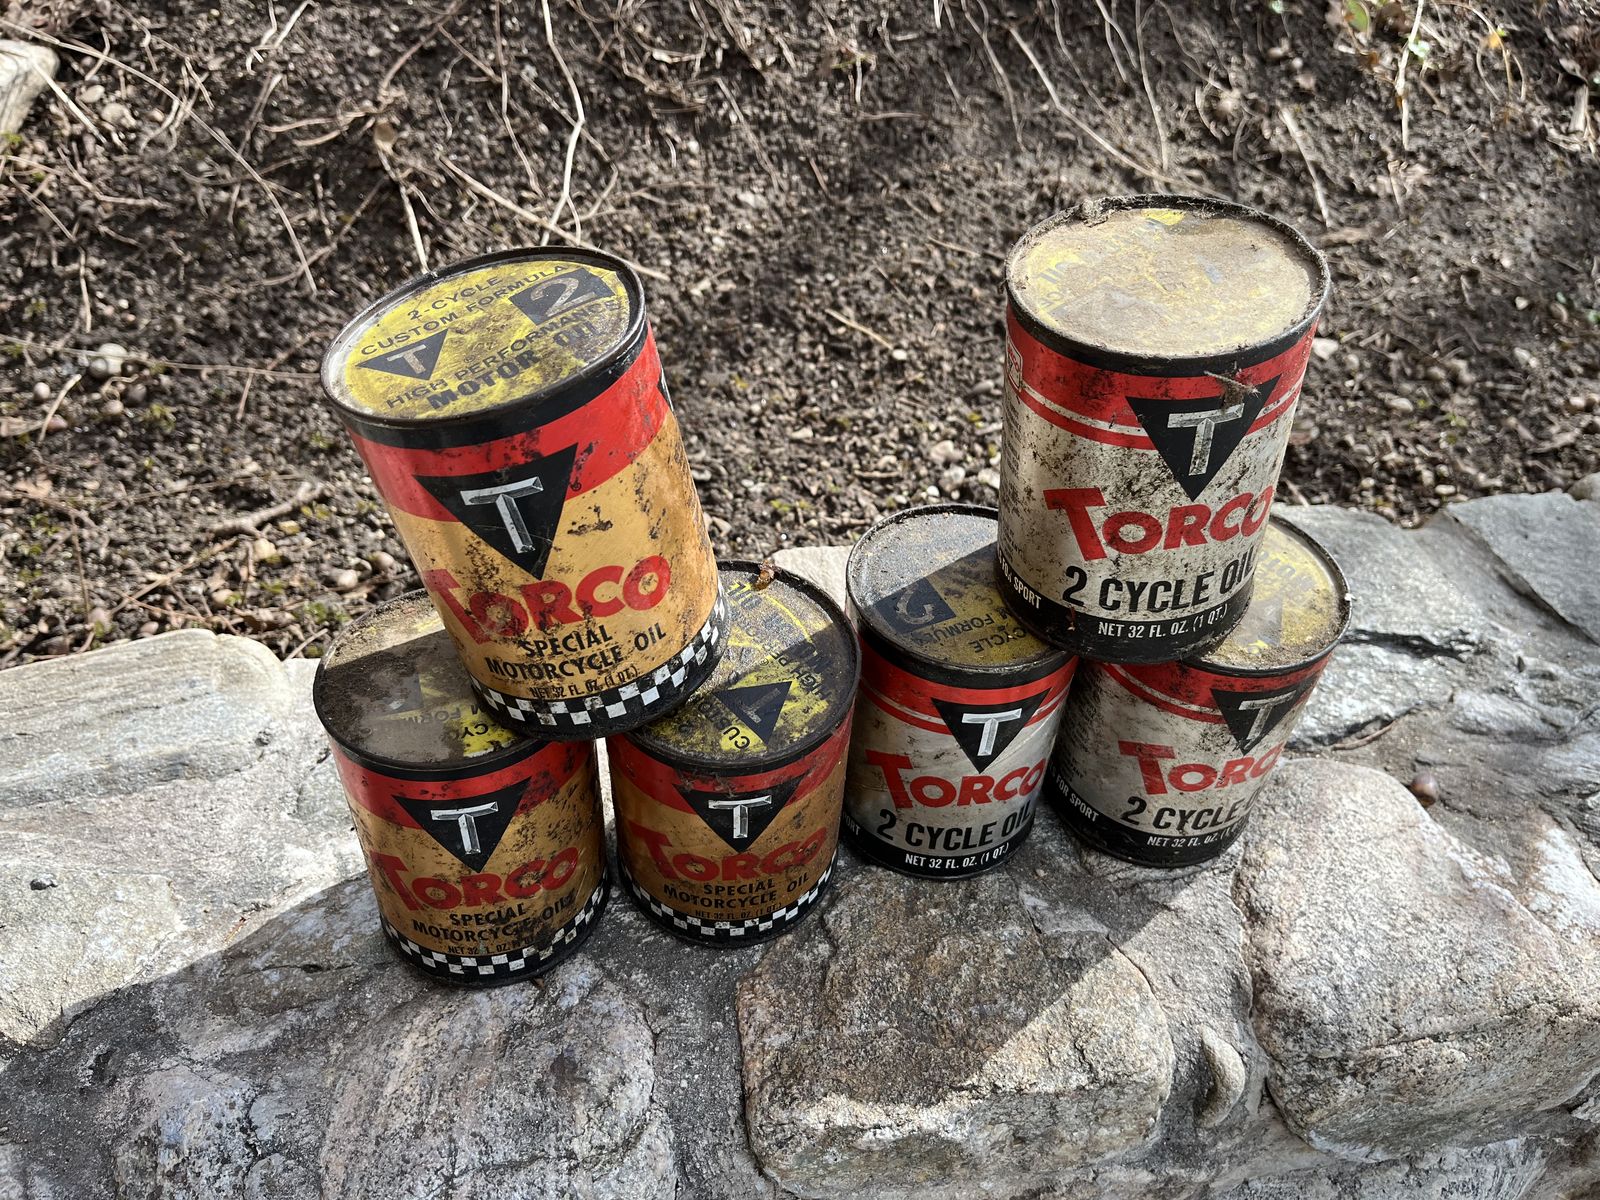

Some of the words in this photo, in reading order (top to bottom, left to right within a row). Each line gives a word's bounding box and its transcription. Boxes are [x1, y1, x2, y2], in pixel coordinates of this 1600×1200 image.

[361, 310, 458, 357] CUSTOM
[466, 264, 568, 313] FORMULA
[531, 277, 598, 317] 2
[386, 378, 449, 409] HIGH
[454, 299, 624, 382] PERFORMANCE
[386, 345, 427, 375] T
[426, 350, 543, 411] MOTOR
[552, 320, 600, 348] OIL
[1167, 404, 1244, 476] T
[460, 477, 544, 553] T
[1042, 485, 1275, 561] TORCO
[424, 555, 671, 645] TORCO
[1013, 576, 1042, 609] SPORT
[1062, 566, 1088, 607] 2
[1099, 570, 1215, 613] CYCLE
[519, 623, 613, 659] SPECIAL
[1098, 621, 1125, 638] NET
[1127, 624, 1145, 638] 32
[1149, 622, 1166, 638] FL.
[1171, 618, 1189, 634] OZ.
[1193, 614, 1204, 632] (1
[1208, 603, 1228, 625] QT.)
[485, 644, 623, 681] MOTORCYCLE
[634, 622, 666, 652] OIL
[529, 687, 551, 698] NET
[568, 684, 585, 696] FL.
[962, 708, 1022, 756] T
[865, 749, 1046, 809] TORCO
[1056, 775, 1069, 797] FOR
[1070, 792, 1100, 822] SPORT
[431, 801, 498, 855] T
[708, 795, 772, 839] T
[876, 808, 897, 841] 2
[905, 820, 998, 850] CYCLE
[1002, 801, 1031, 837] OIL
[1119, 796, 1148, 826] 2
[1152, 798, 1245, 830] CYCLE
[629, 820, 827, 881] TORCO
[905, 853, 927, 867] NET
[928, 858, 941, 868] 32
[945, 859, 959, 870] FL.
[963, 856, 978, 867] OZ.
[981, 849, 990, 864] (1
[993, 842, 1009, 859] QT.)
[1147, 836, 1169, 847] NET
[1171, 838, 1185, 848] 32
[371, 847, 579, 911] TORCO
[663, 884, 777, 910] MOTORCYCLE
[787, 873, 809, 893] OIL
[703, 879, 775, 896] SPECIAL
[449, 903, 526, 926] SPECIAL
